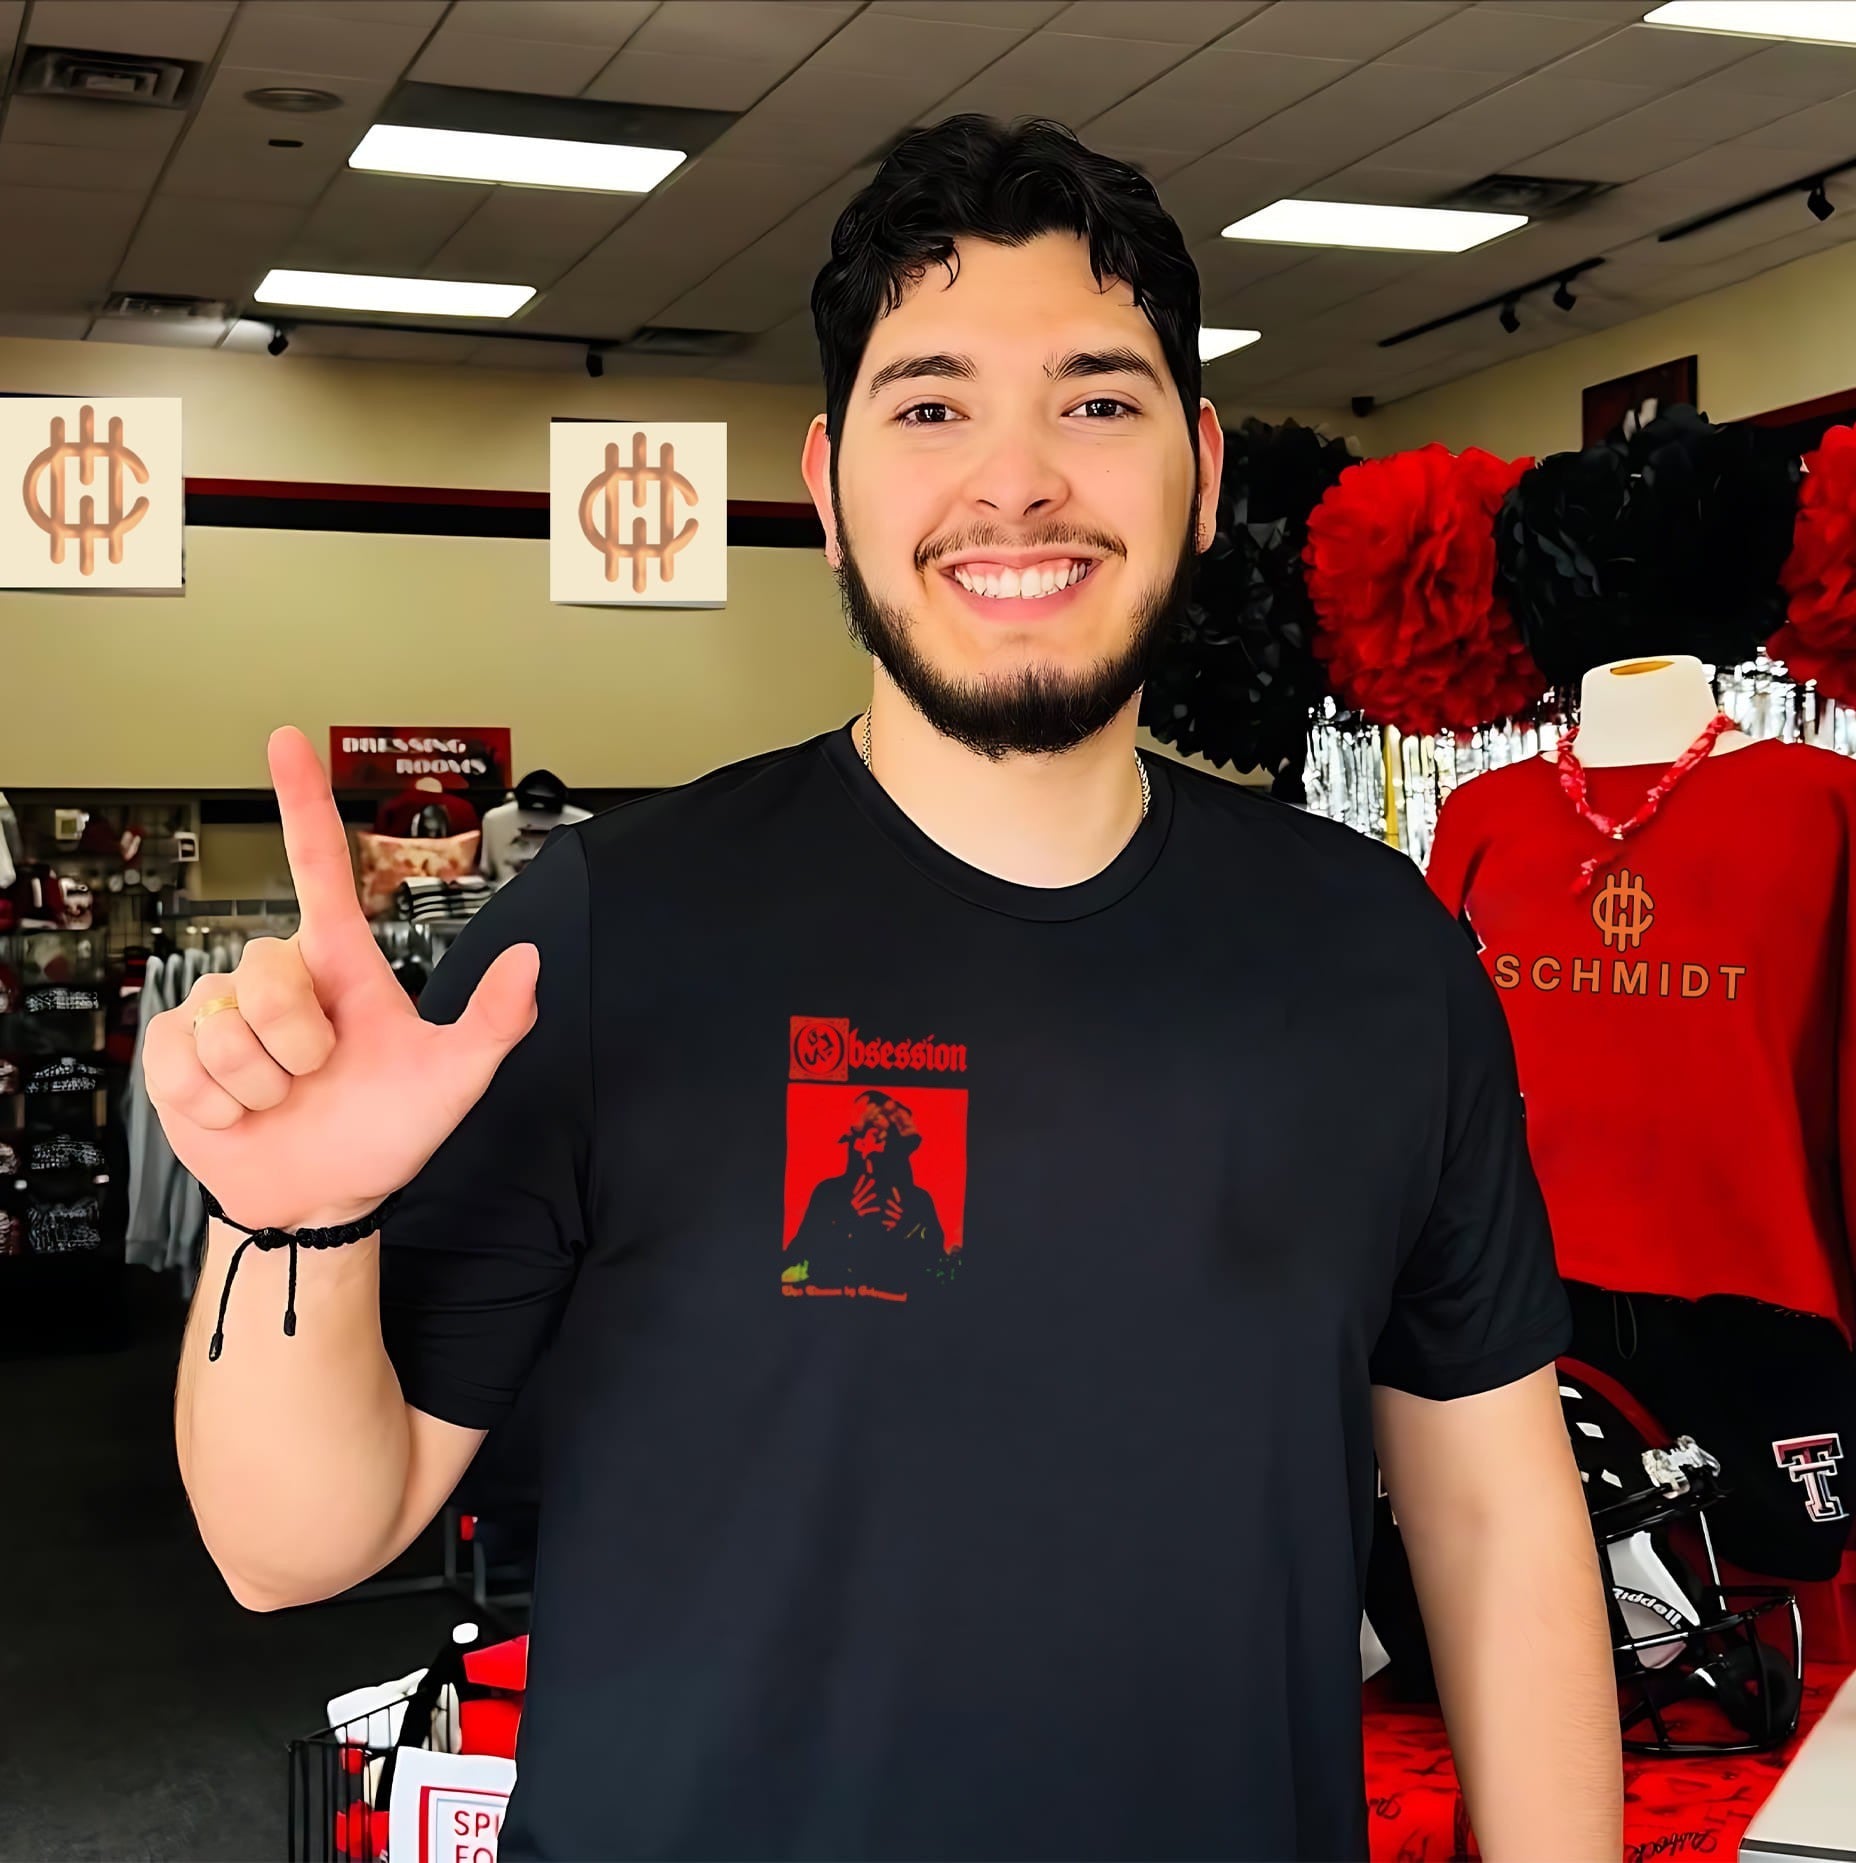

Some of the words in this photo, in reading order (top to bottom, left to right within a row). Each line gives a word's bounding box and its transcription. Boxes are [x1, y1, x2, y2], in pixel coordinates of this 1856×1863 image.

[342, 737, 467, 753] DRESSING
[395, 758, 487, 775] ROOMS
[1494, 953, 1747, 1000] SCHMIDT
